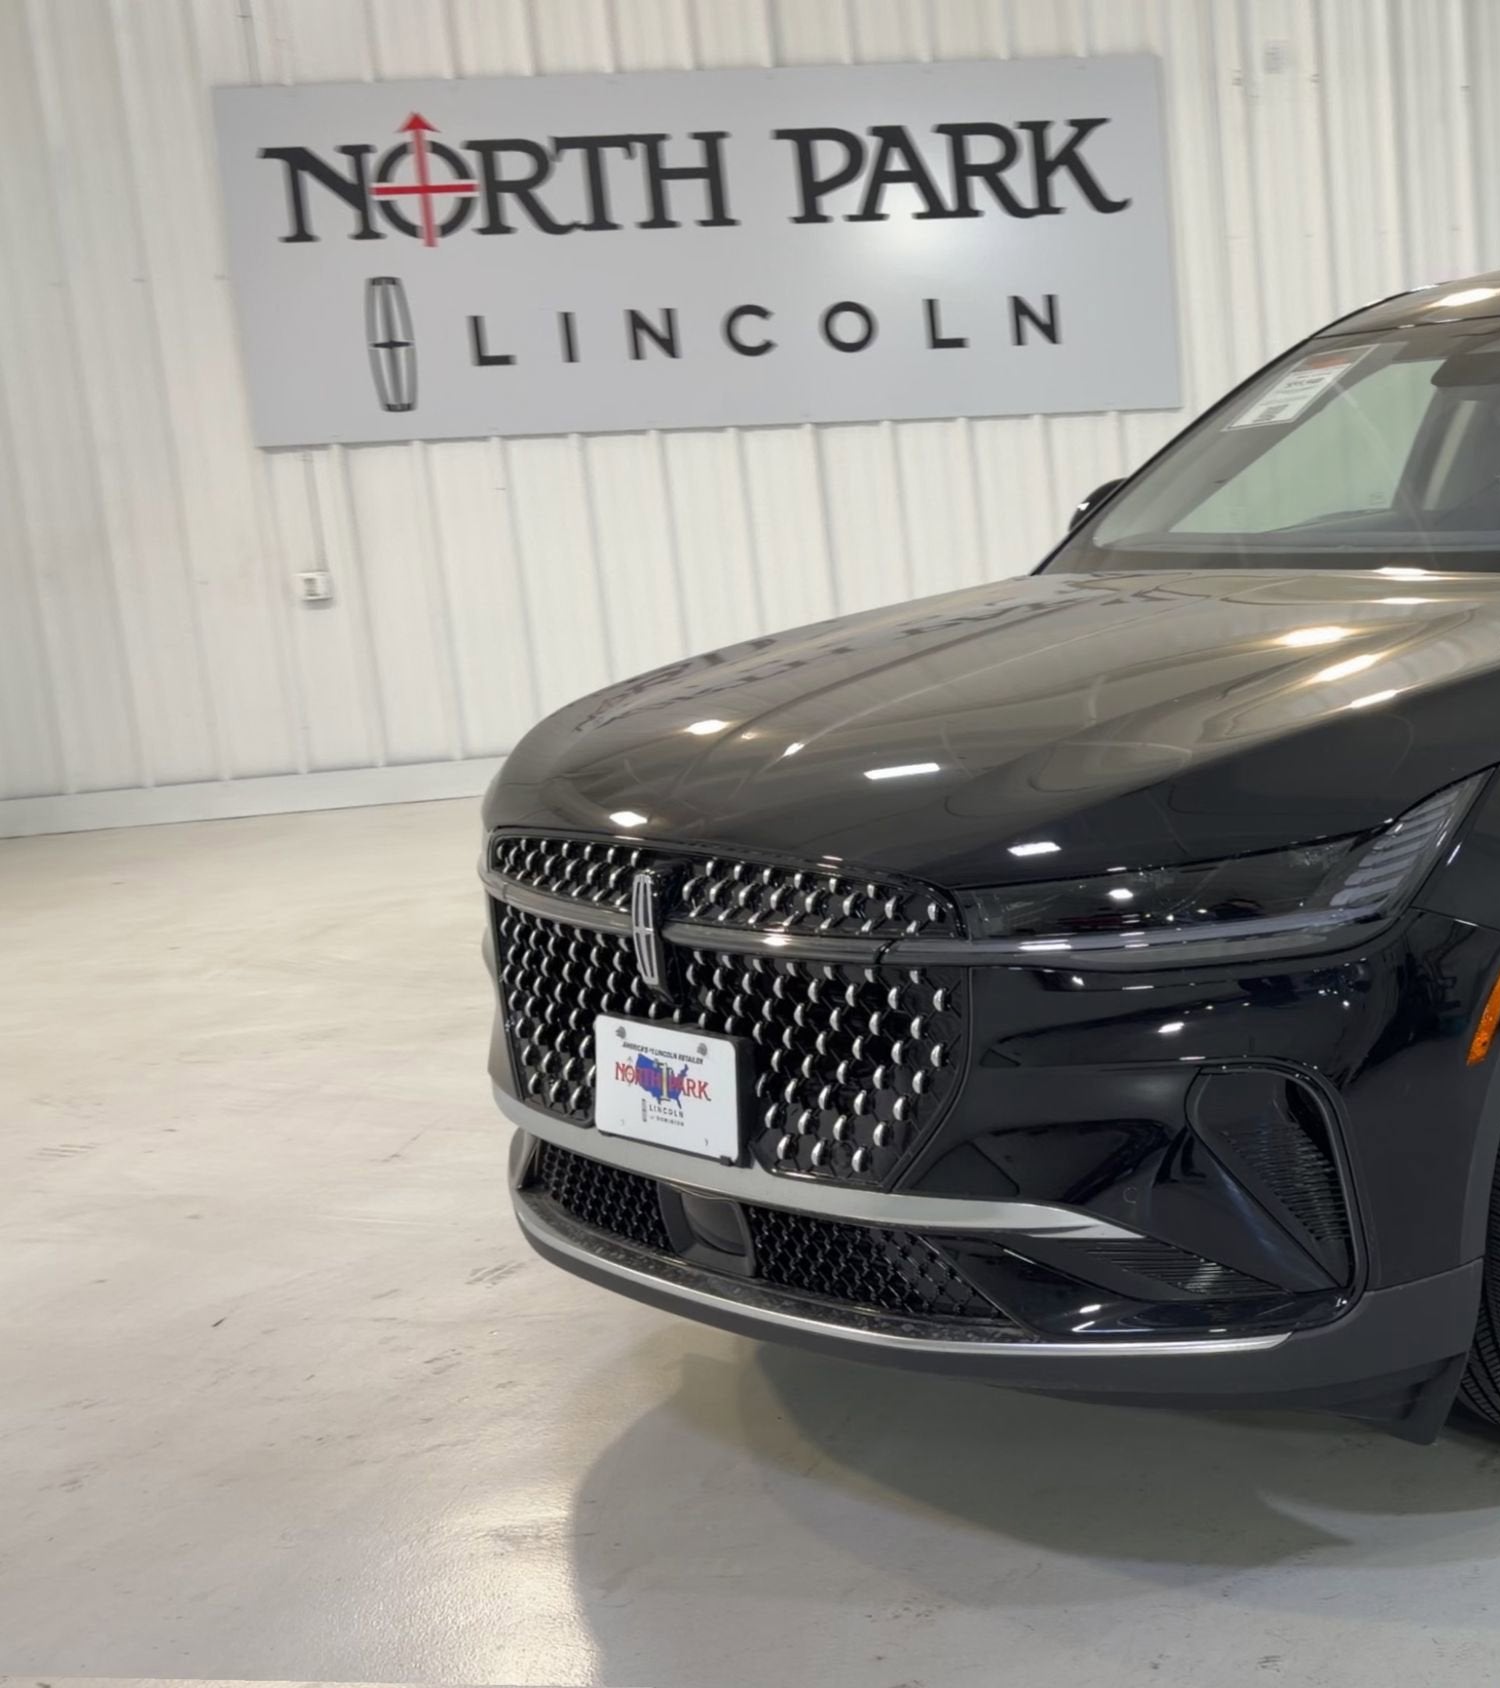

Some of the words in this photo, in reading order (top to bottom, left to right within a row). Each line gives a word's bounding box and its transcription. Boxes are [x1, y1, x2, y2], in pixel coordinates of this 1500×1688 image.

[261, 127, 741, 244] NORTH
[773, 117, 1132, 225] PARK
[468, 293, 1062, 367] LINCOLN
[649, 1104, 684, 1119] LINCOLN
